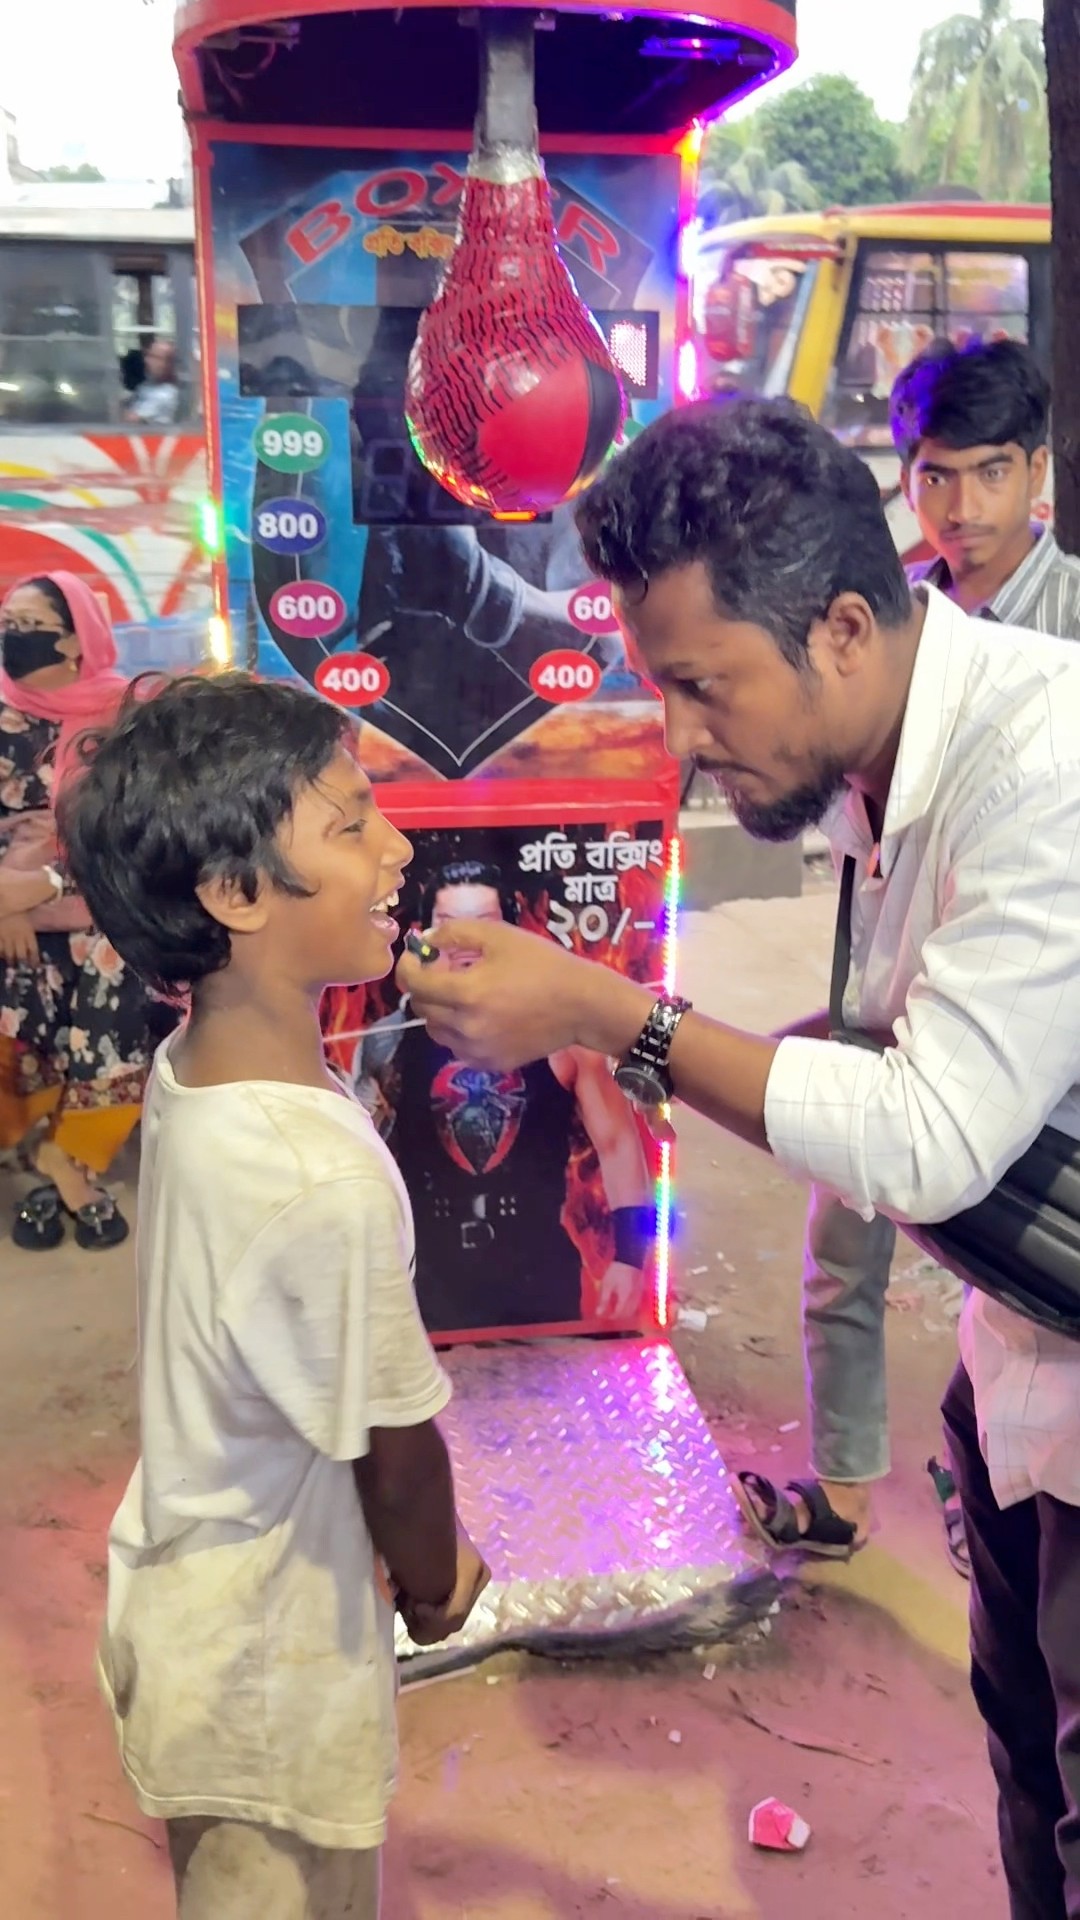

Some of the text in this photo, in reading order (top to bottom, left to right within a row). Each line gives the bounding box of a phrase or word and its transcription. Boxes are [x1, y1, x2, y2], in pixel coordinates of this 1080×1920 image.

[286, 162, 620, 275] BOXR
[262, 430, 323, 457] 999
[258, 512, 318, 540] 800
[277, 595, 336, 621] 600
[573, 595, 613, 621] 60
[322, 667, 380, 692] 400
[538, 665, 595, 690] 400
[518, 832, 664, 872] প্রতি বক্সিং
[563, 872, 618, 904] মাত্র
